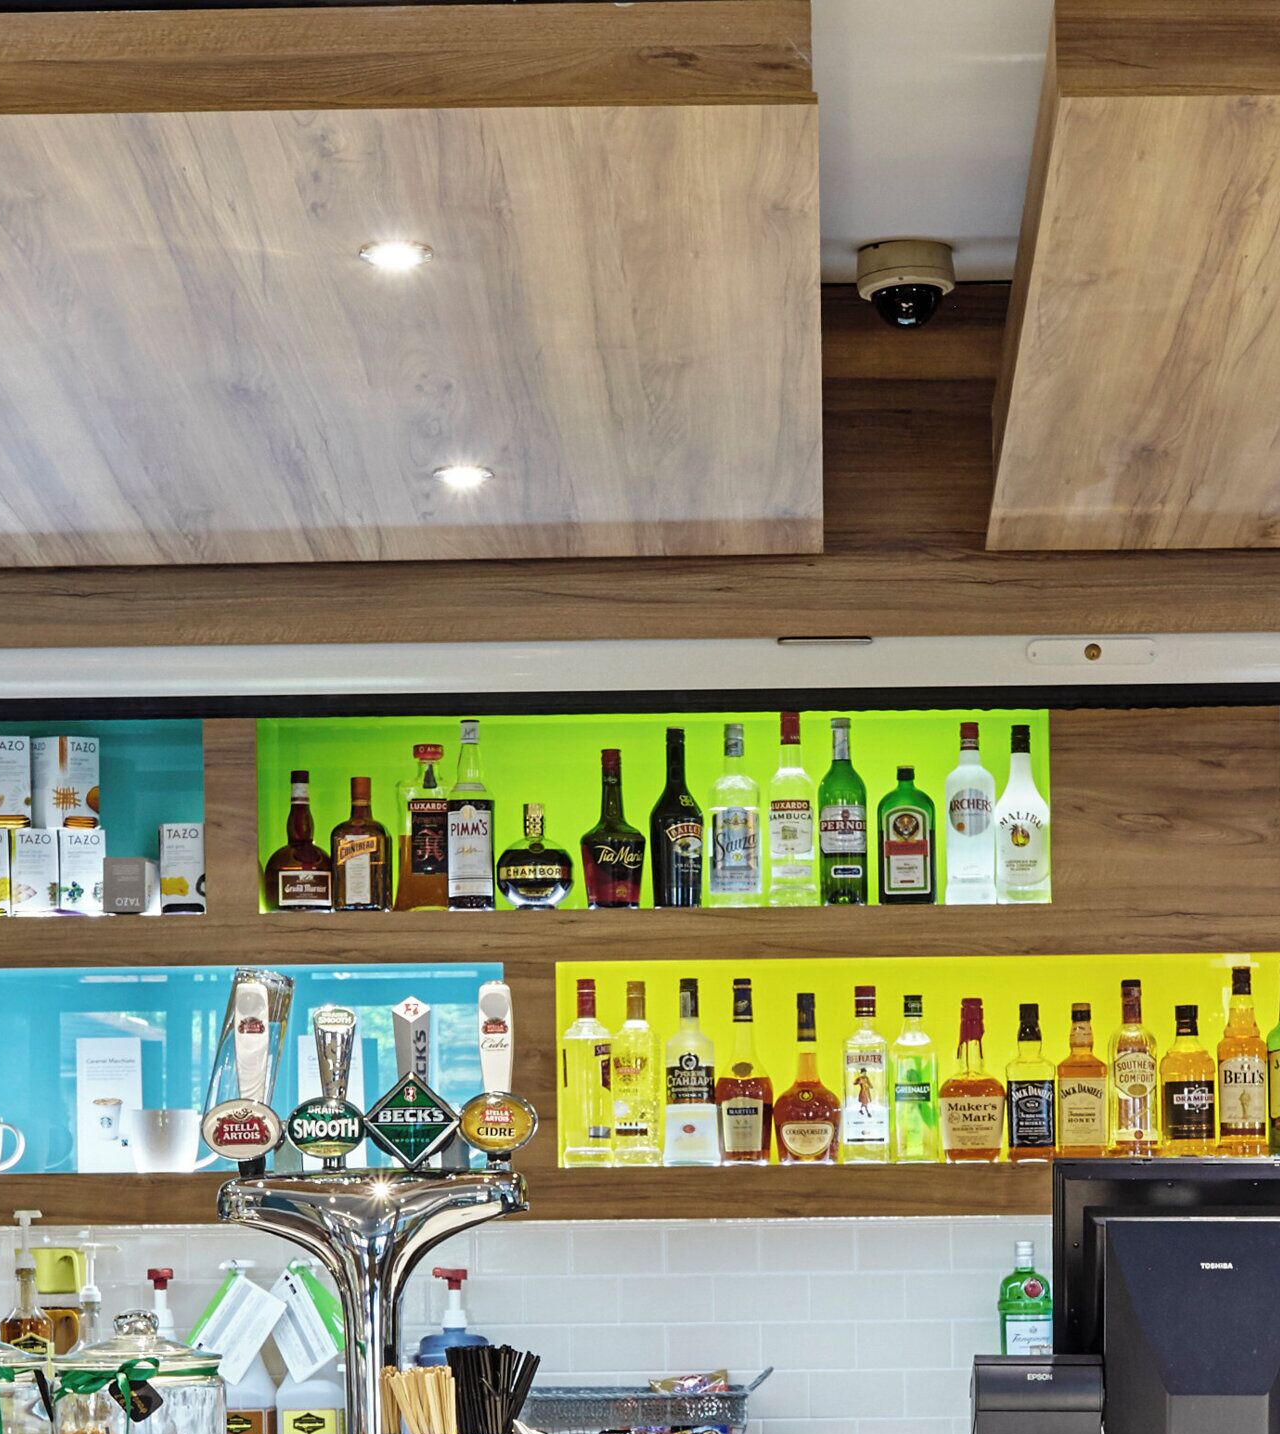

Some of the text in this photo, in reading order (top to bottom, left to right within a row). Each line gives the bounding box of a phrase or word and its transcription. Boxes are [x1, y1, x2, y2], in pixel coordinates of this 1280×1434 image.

[70, 741, 96, 753] TAZO
[950, 798, 993, 812] ARCHERS
[999, 811, 1044, 829] MALIBU
[166, 828, 199, 839] TAZO
[450, 819, 488, 837] PIMM'S
[19, 834, 52, 845] TAZO
[68, 835, 101, 845] TAZO
[715, 833, 756, 862] Sauza
[594, 845, 615, 864] Tia
[115, 897, 141, 907] TAZO
[318, 1016, 353, 1024] SMOOTH
[481, 1038, 509, 1049] Cidre
[415, 1029, 427, 1082] CK'S
[1117, 1060, 1155, 1072] SOUTHERN
[1119, 1073, 1154, 1083] COMFORT
[1224, 1069, 1264, 1084] BELL'S
[1012, 1088, 1028, 1101] JACK
[1061, 1083, 1103, 1099] JACK DANIEL'S
[307, 1105, 345, 1114] BRAINS
[947, 1102, 997, 1112] Maker's
[377, 1107, 444, 1123] BECK'S
[484, 1115, 510, 1123] ARTOIS
[962, 1113, 997, 1122] Mark
[223, 1123, 260, 1132] STELLA
[293, 1118, 359, 1138] SMOOTH
[477, 1126, 516, 1138] CIDRE
[223, 1132, 261, 1141] ARTOIS
[1027, 1373, 1052, 1381] EPSON
